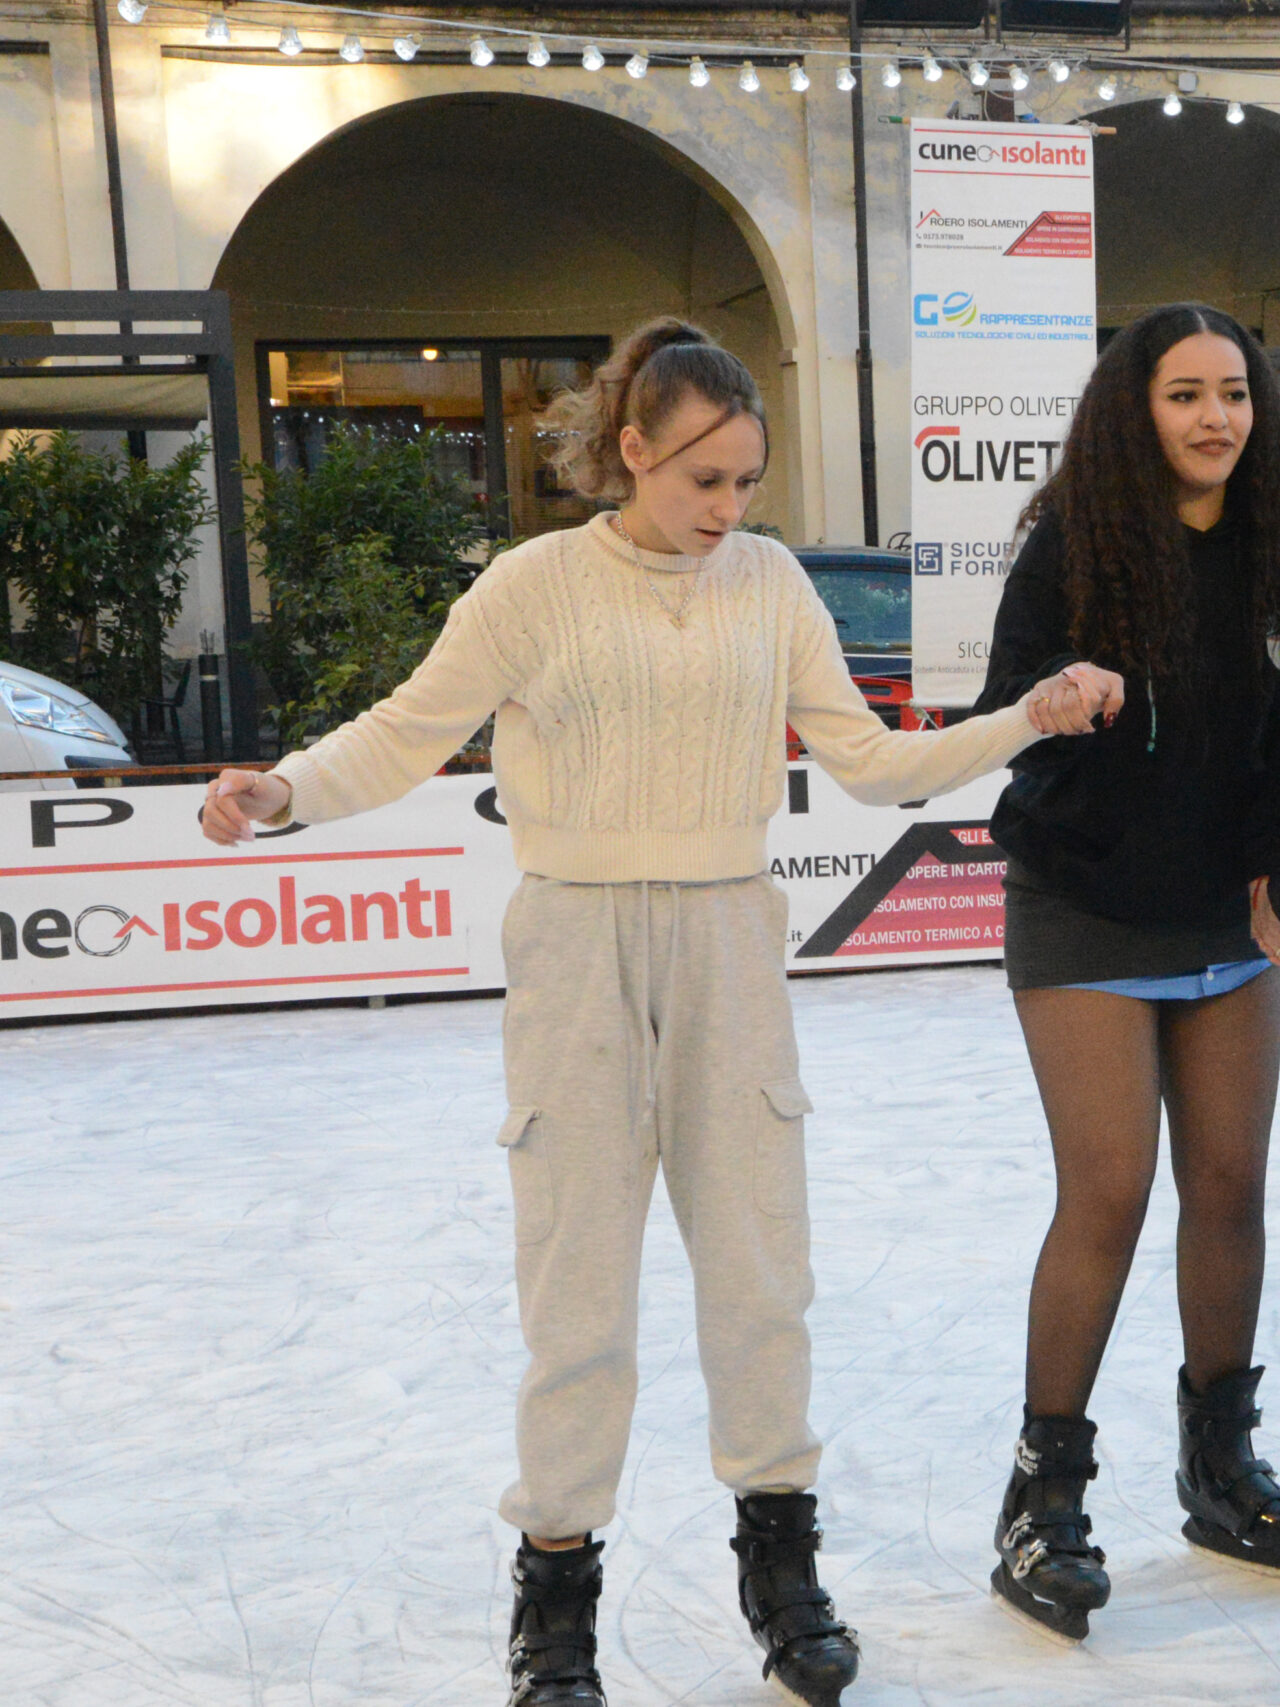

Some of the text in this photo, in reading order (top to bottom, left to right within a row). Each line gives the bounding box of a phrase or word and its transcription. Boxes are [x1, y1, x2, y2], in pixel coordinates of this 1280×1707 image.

[1002, 141, 1086, 165] isolanti
[930, 217, 1028, 229] ROERO ISOLAMENTI
[979, 313, 1094, 327] RAPPRESENTANZE
[914, 395, 1004, 416] GRUPPO
[958, 830, 978, 844] GLI
[906, 864, 948, 880] OPERE
[951, 864, 964, 877] IN
[950, 895, 974, 909] CON
[163, 876, 452, 952] isolanti
[925, 927, 981, 942] TERMICO
[984, 926, 992, 939] A
